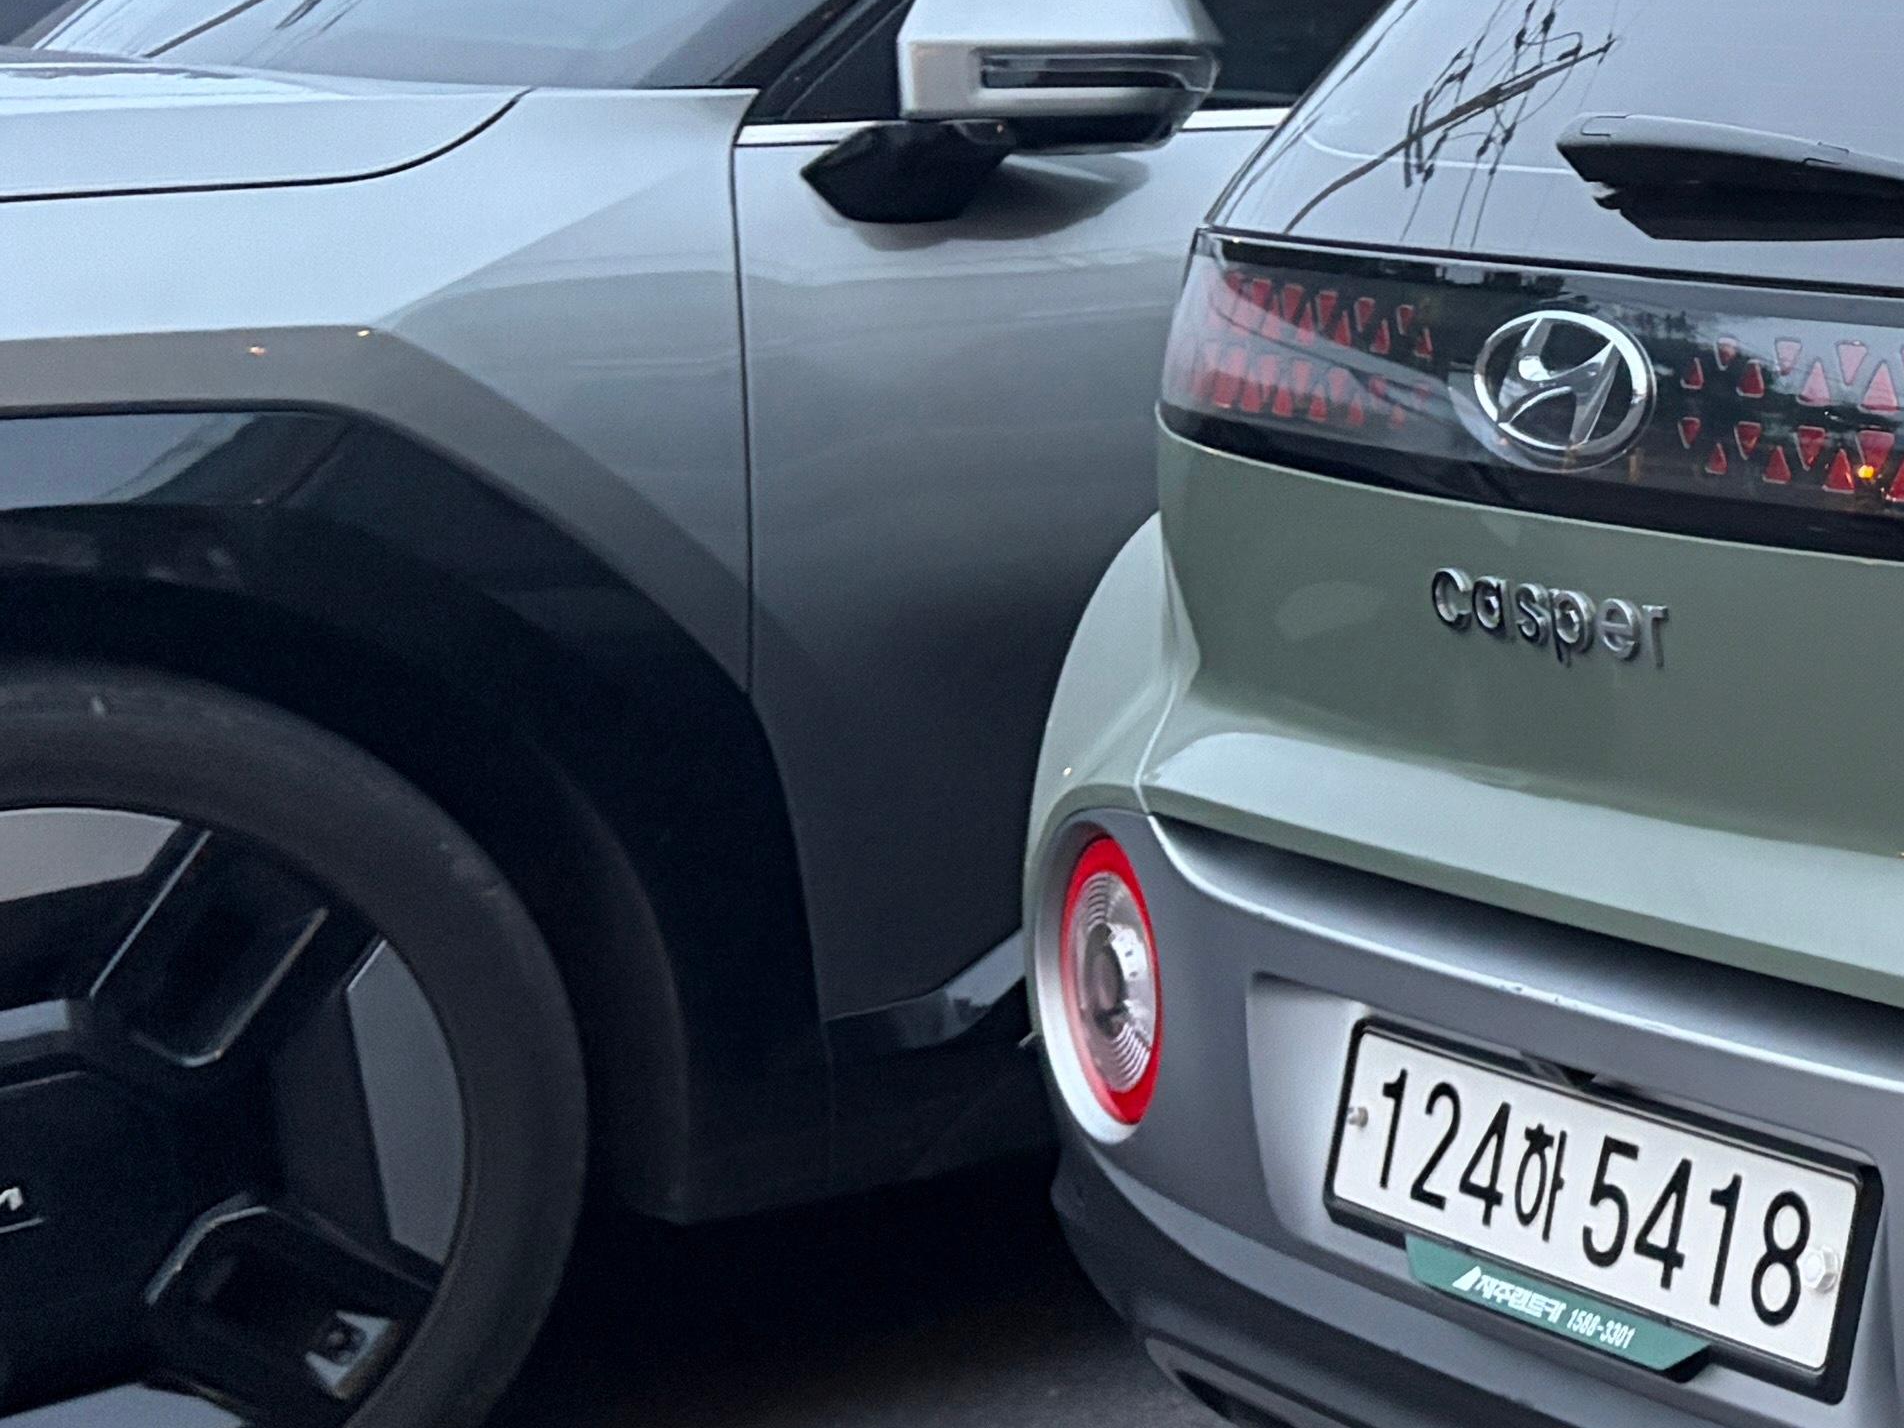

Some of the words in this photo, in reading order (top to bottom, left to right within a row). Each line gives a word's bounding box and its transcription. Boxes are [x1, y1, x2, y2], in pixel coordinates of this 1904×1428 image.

[1432, 567, 1669, 668] casper
[1379, 1067, 1569, 1242] 124하
[1581, 1133, 1811, 1327] 5418
[1475, 1273, 1568, 1325] 제주렌트카
[1567, 1307, 1637, 1350] 1588-3301
